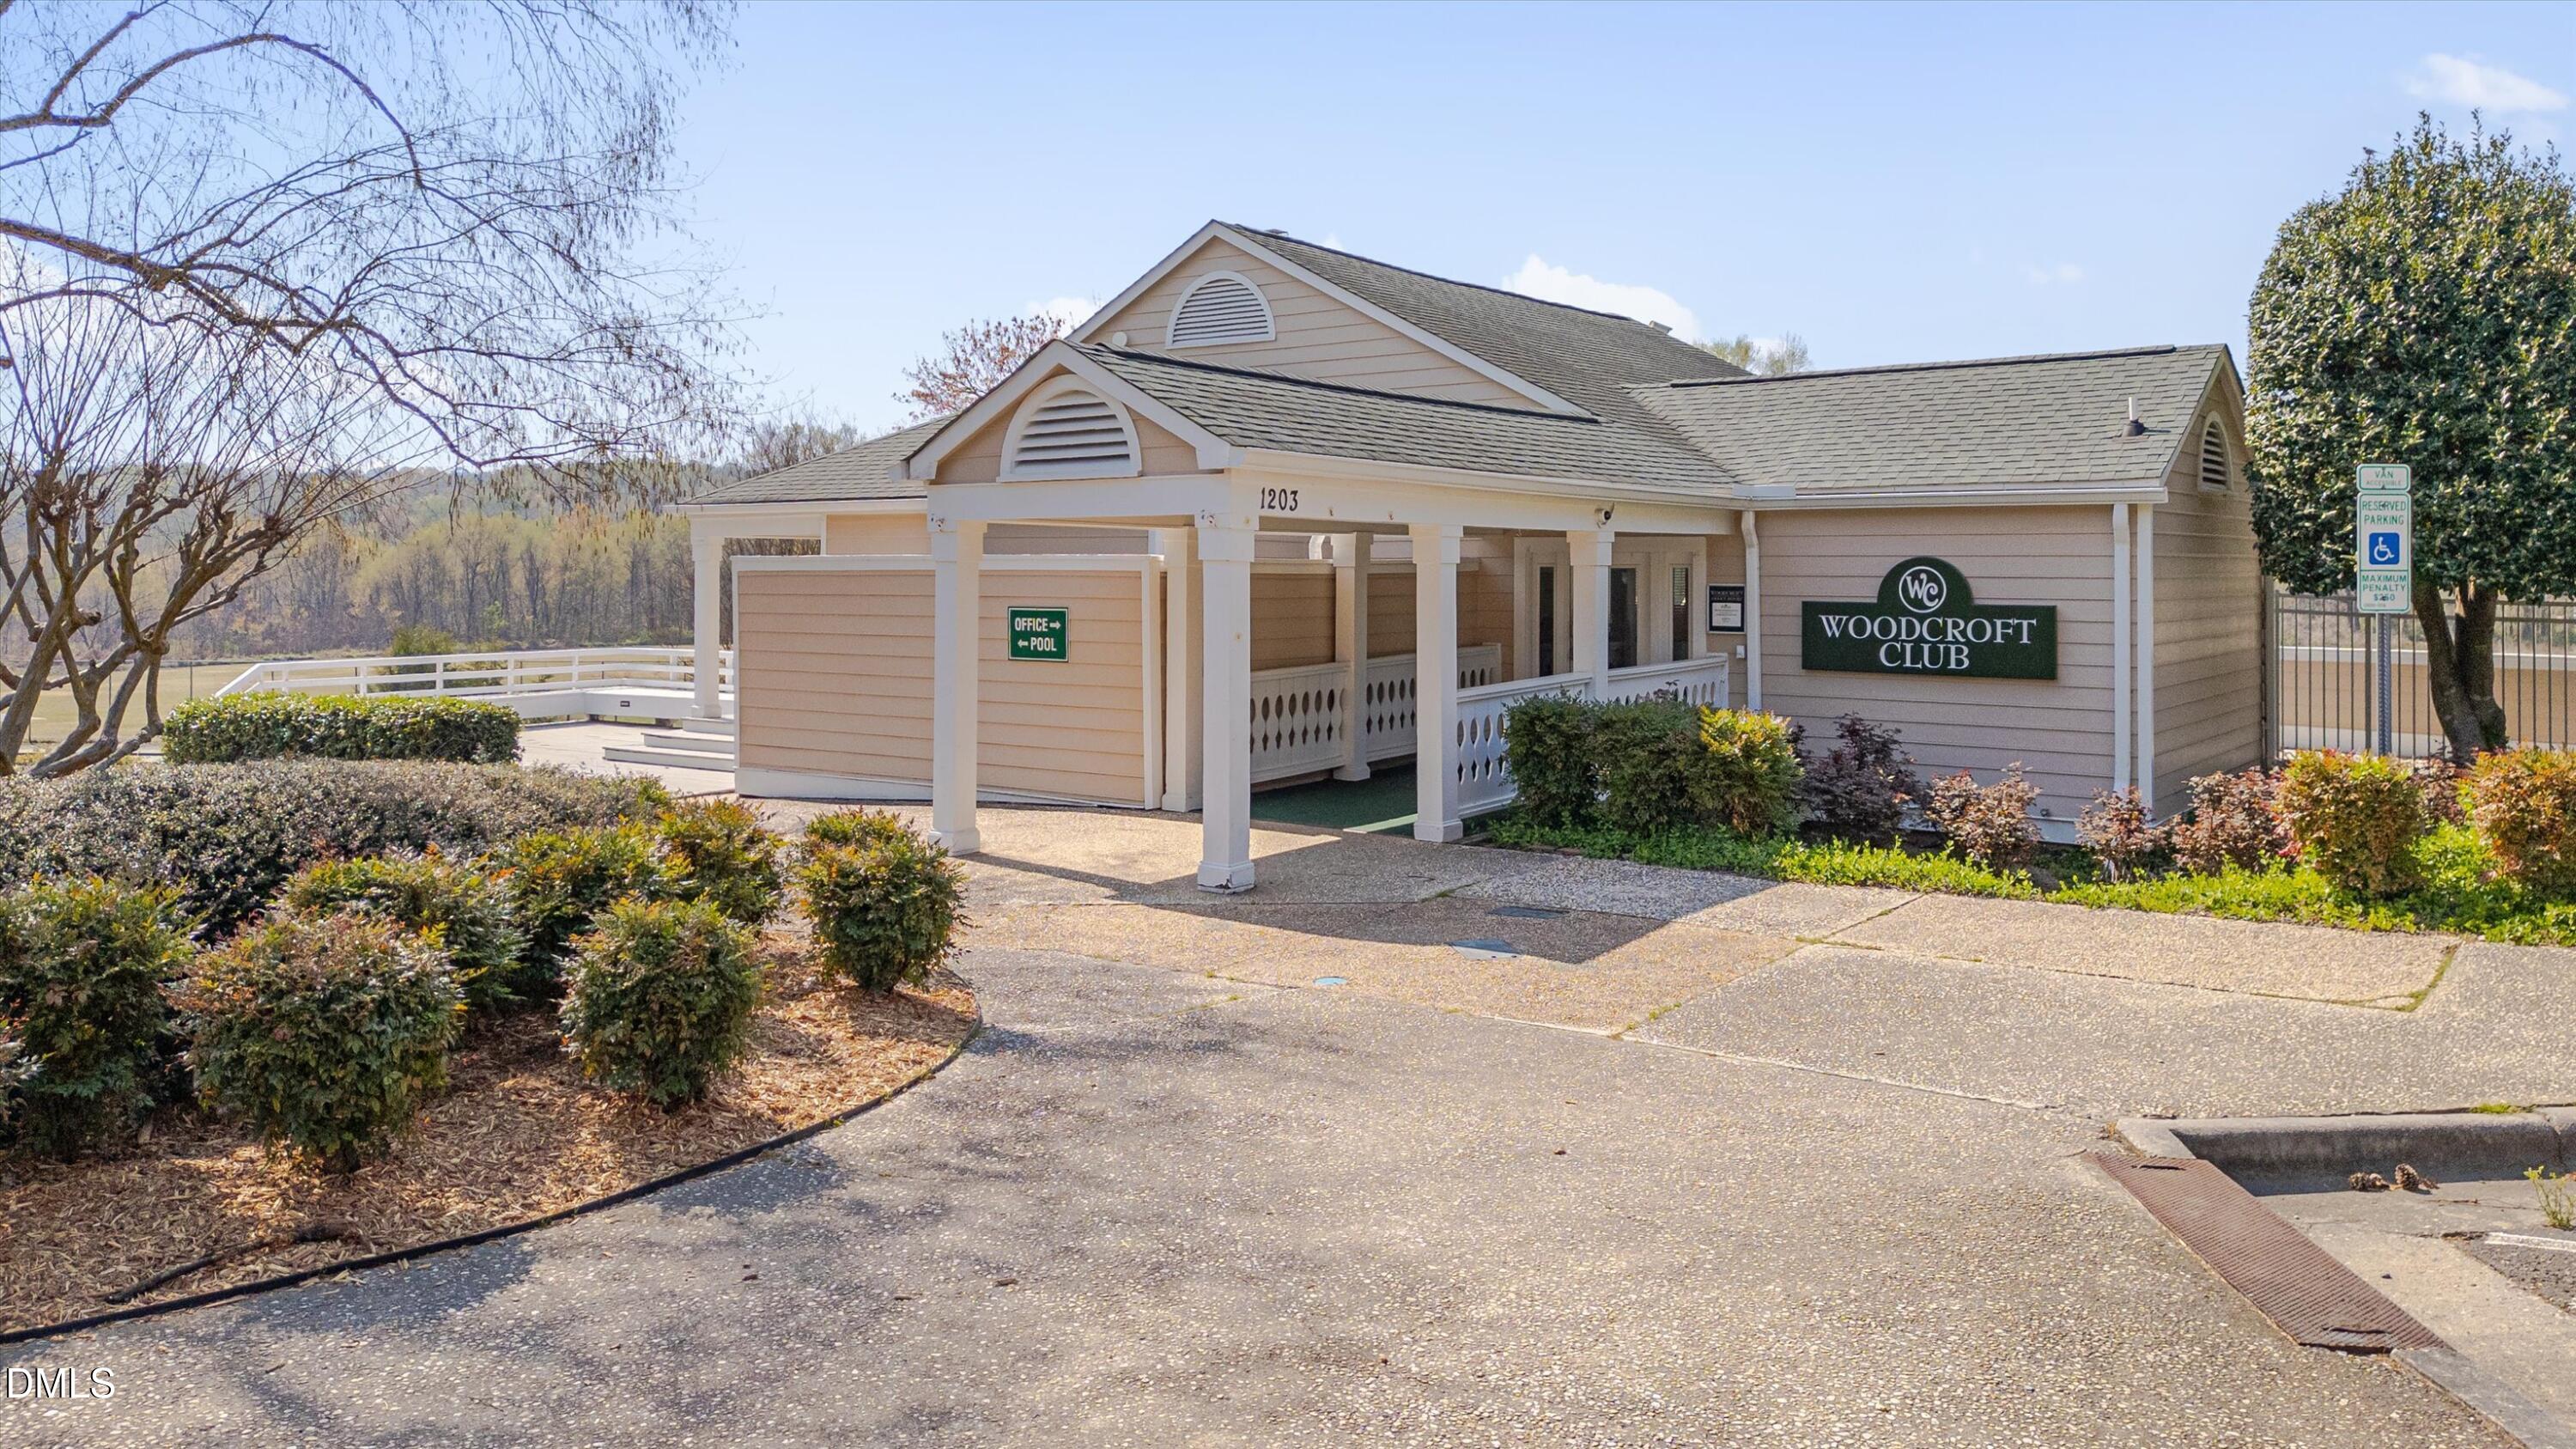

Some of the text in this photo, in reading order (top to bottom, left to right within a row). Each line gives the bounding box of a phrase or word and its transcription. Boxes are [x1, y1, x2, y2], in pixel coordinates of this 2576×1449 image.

[1260, 487, 1298, 511] 1203
[2362, 501, 2407, 511] RESERVED
[2364, 514, 2404, 525] PARKING
[1014, 617, 1048, 632] OFFICE
[1819, 614, 2037, 644] WOODCROFT
[1030, 636, 1057, 652] POOL
[1879, 642, 1970, 670] CLUB
